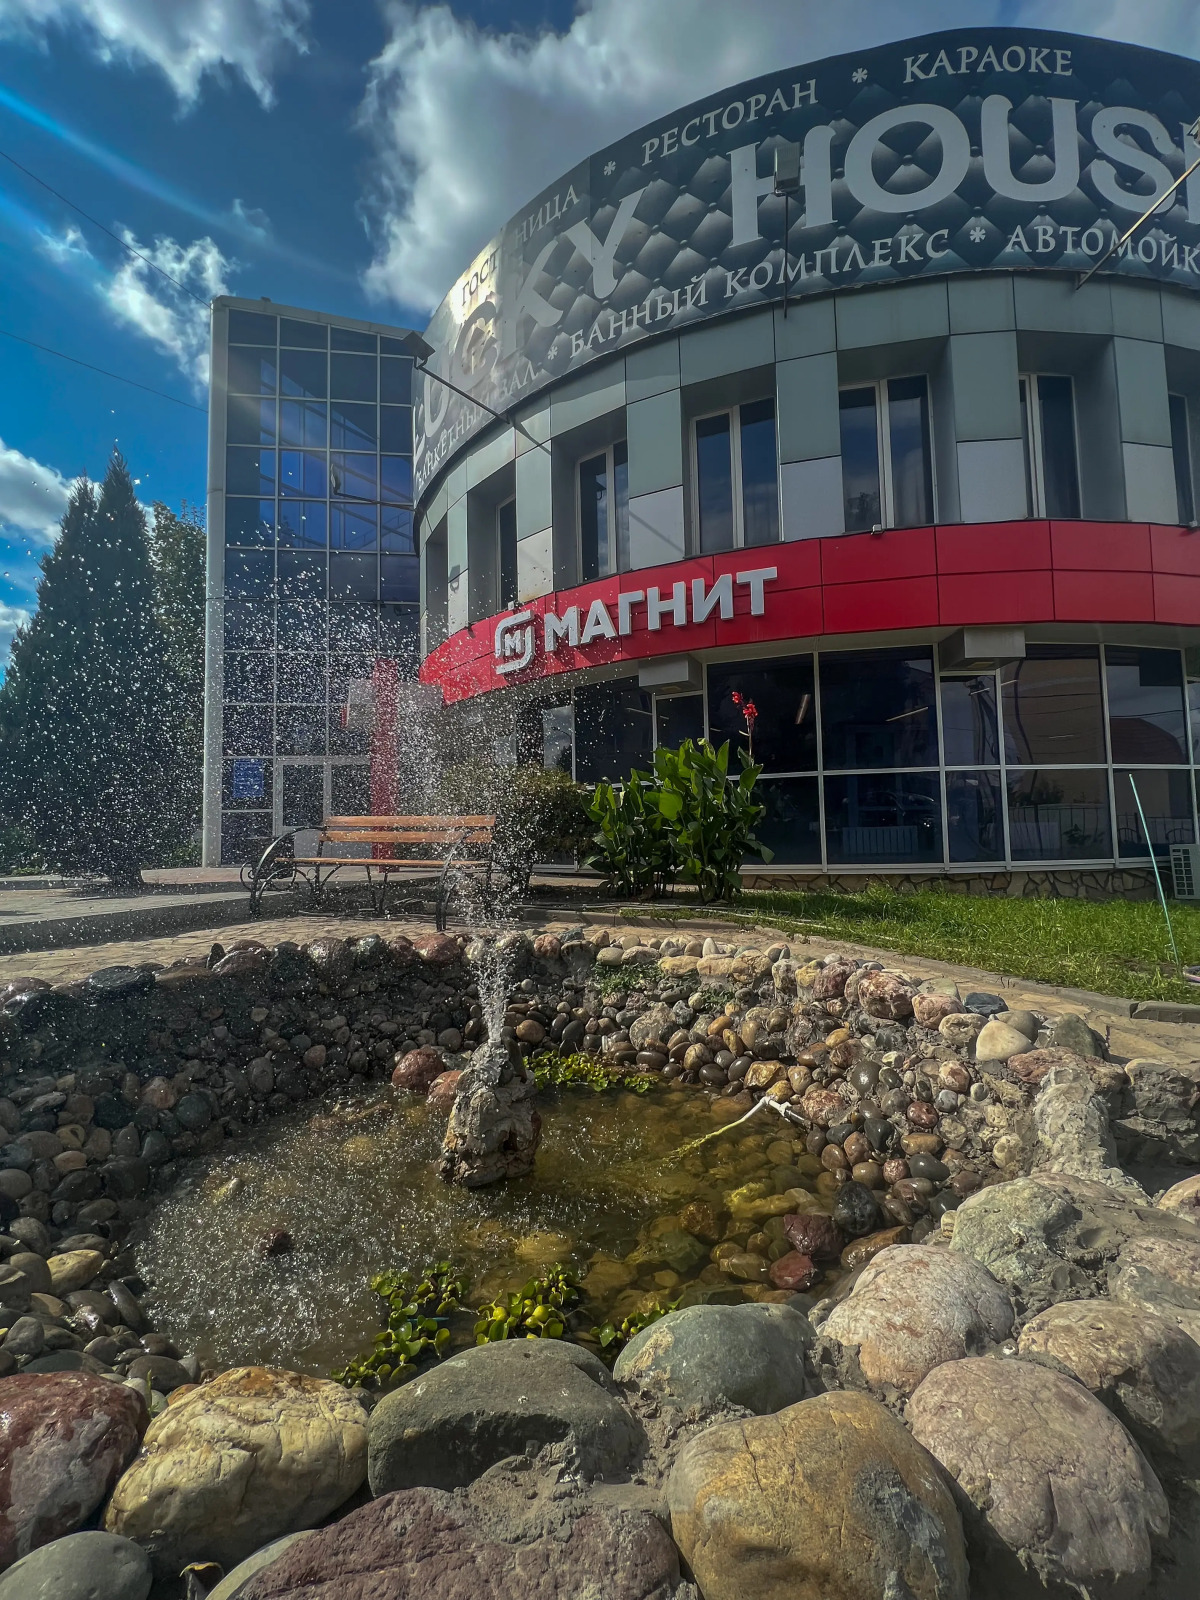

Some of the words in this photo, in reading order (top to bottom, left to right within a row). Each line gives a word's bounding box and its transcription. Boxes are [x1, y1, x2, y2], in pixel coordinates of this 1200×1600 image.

[462, 184, 580, 307] ГОСТНИЦА
[642, 79, 818, 166] РЕСТОРАН
[903, 46, 1073, 83] КАРАОКЕ
[726, 94, 1200, 248] HOUS
[570, 276, 709, 358] БАННЫЙ
[724, 228, 950, 298] КОМПЛЕКС
[544, 566, 778, 652] МАГНИТ
